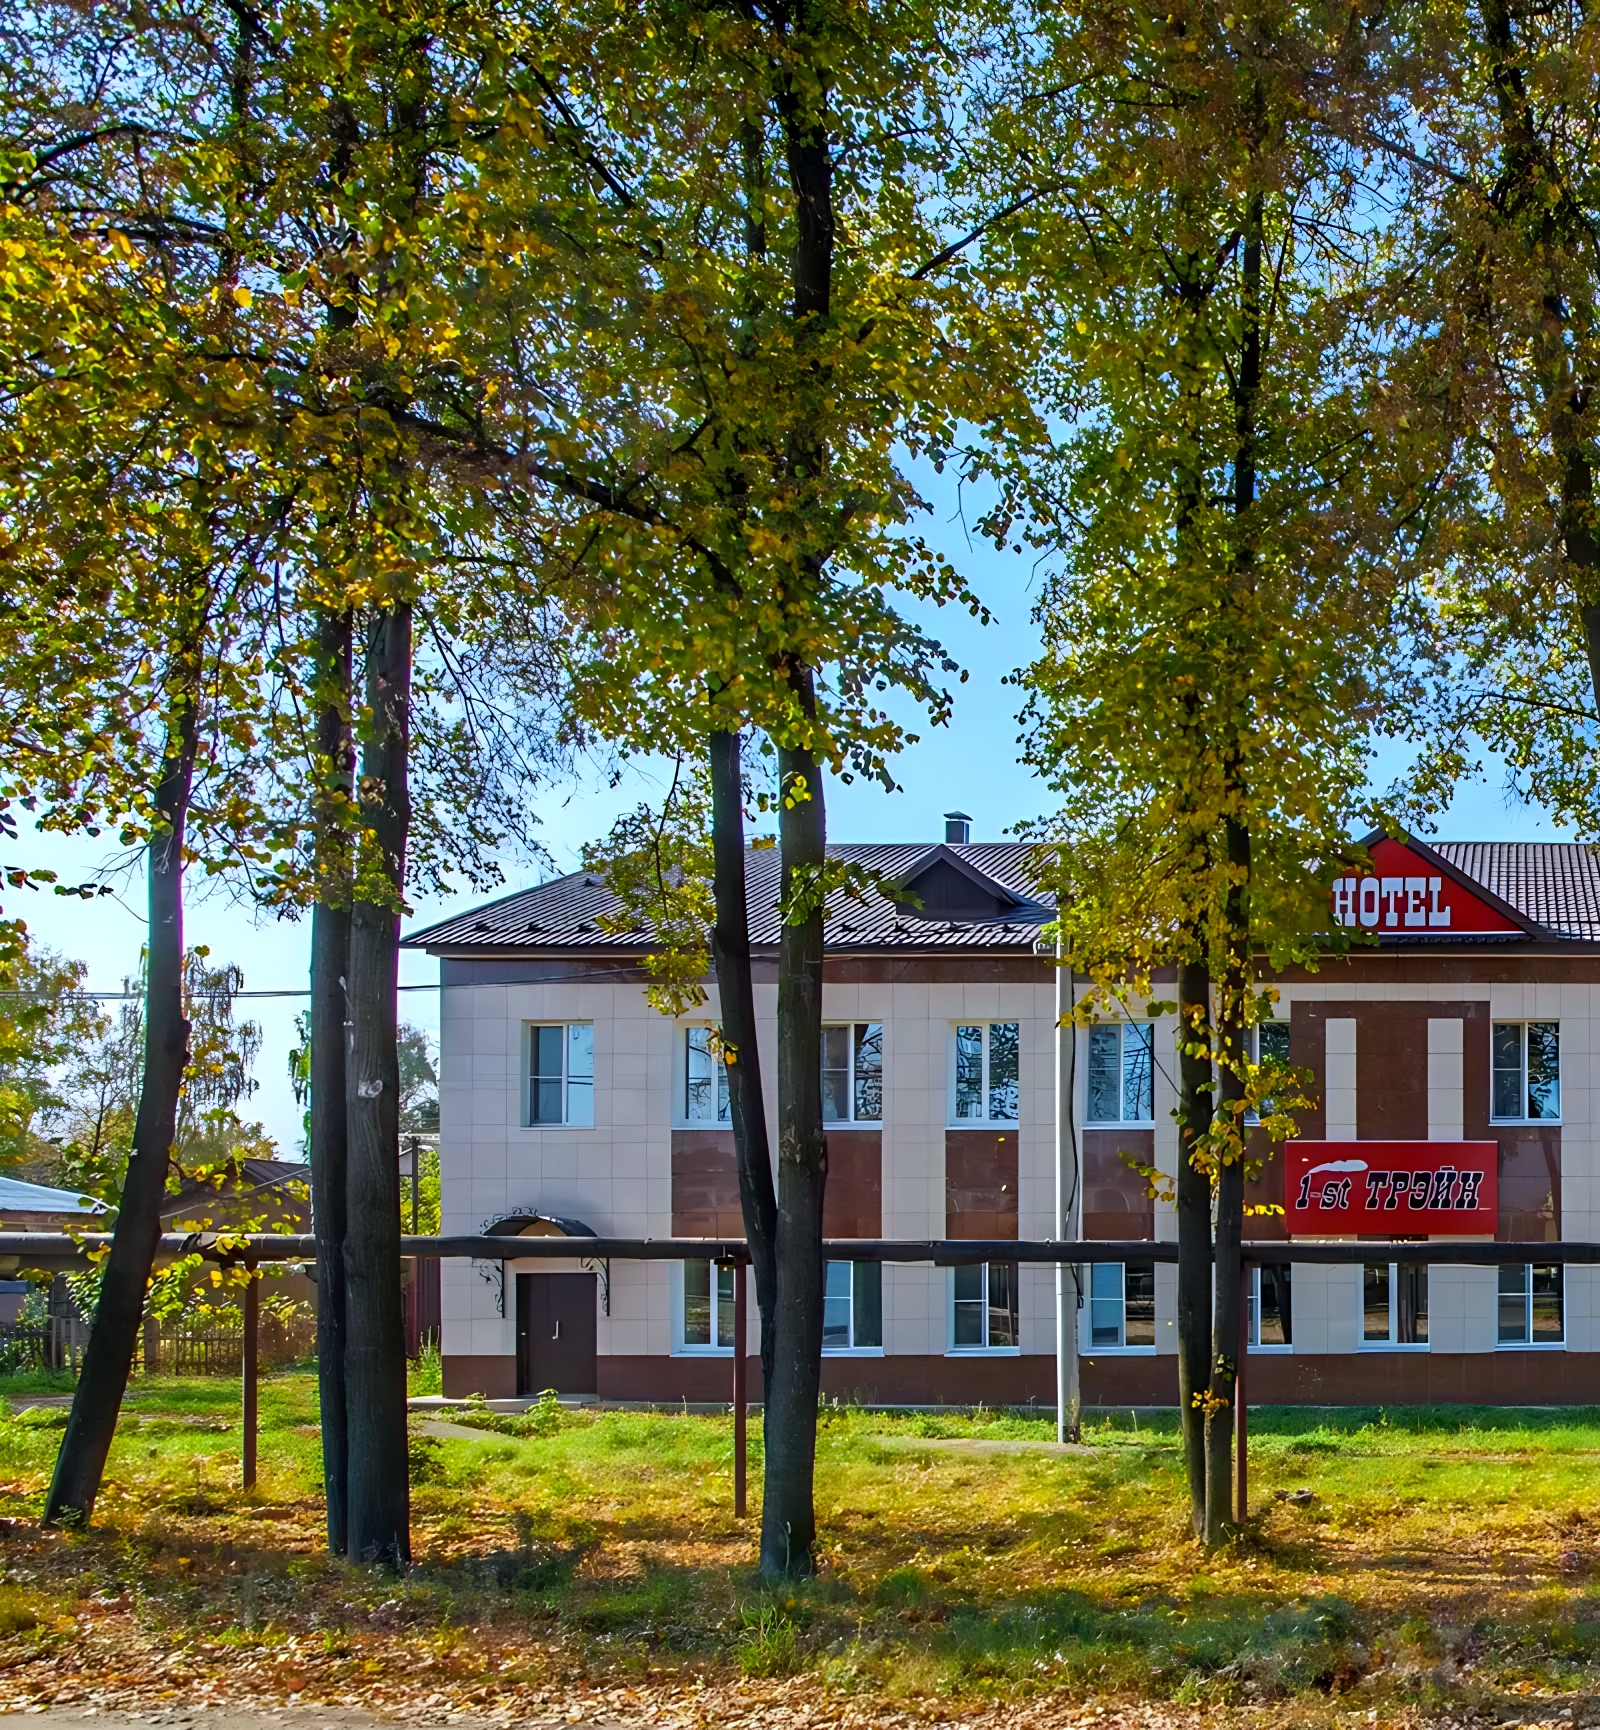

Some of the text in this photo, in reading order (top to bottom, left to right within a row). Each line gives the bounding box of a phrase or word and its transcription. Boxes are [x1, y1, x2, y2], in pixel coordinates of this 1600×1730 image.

[1332, 877, 1450, 927] HOTEL
[1296, 1166, 1484, 1209] 1-st ТРЭЙН
